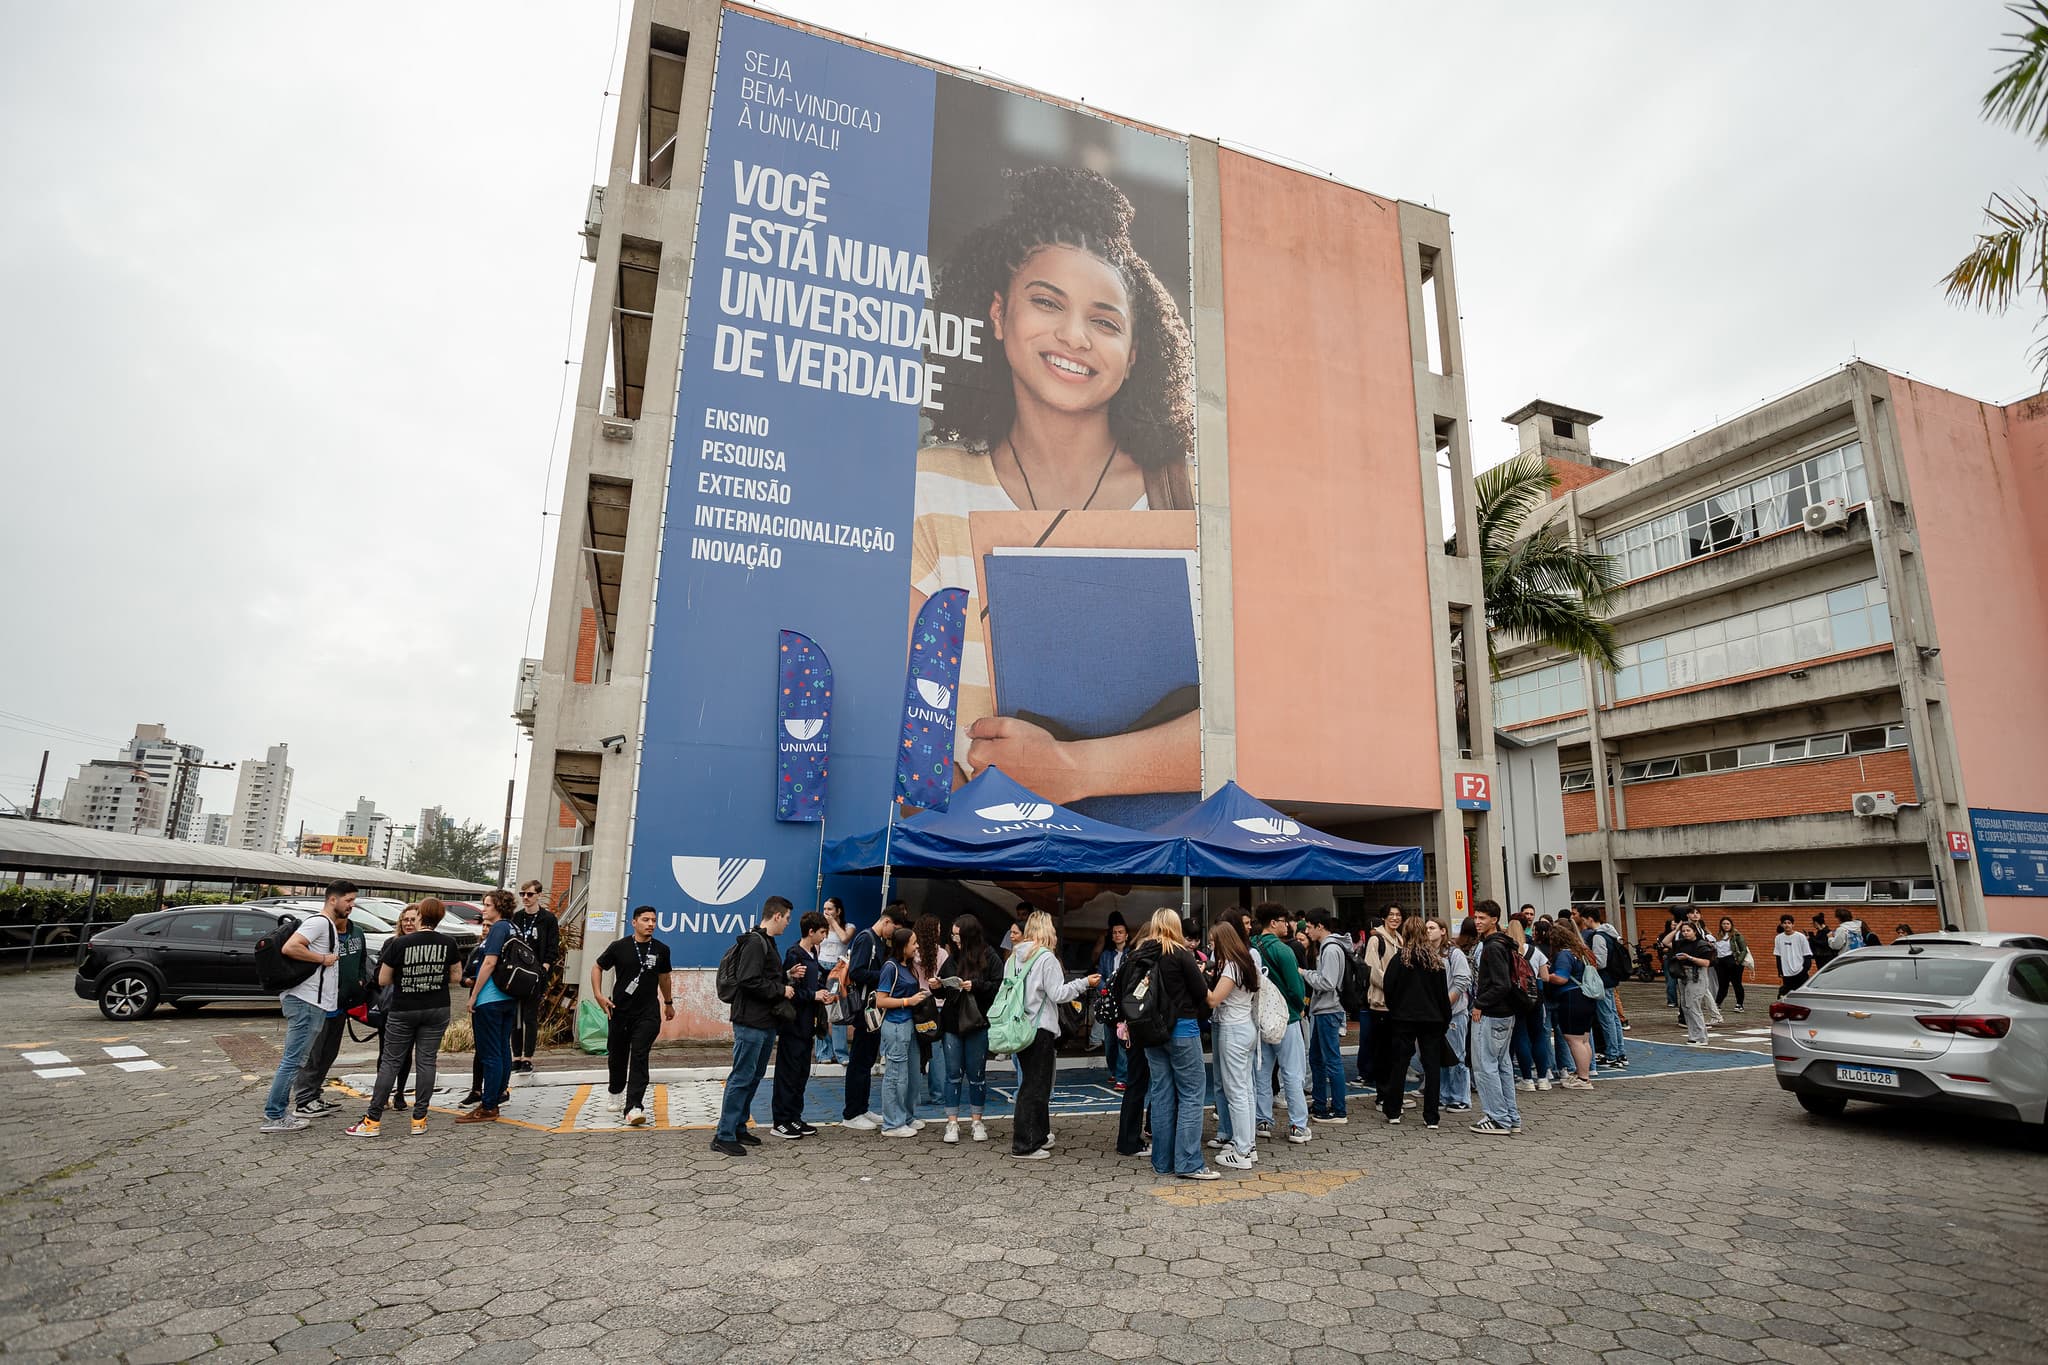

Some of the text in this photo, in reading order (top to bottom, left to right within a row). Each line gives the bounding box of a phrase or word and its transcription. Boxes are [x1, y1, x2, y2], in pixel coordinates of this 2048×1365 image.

[744, 50, 792, 82] SEJA
[741, 77, 881, 133] BEM-VINDO(A)
[738, 102, 841, 151] À UNIVALI!
[733, 159, 831, 223] VOCÊ
[724, 213, 933, 299] ESTÁ NUMA
[719, 267, 985, 363] UNIVERSIDADE
[712, 324, 947, 411] DE VERDADE
[704, 407, 770, 437] ENSINO
[701, 439, 786, 472] PESQUISA
[697, 472, 791, 505] EXTENSÃO
[694, 504, 896, 553] INTERNACIONALIZAÇÃO
[690, 537, 782, 570] INOVAÇÃO
[780, 742, 827, 752] UNIVALI
[1462, 775, 1486, 799] F2
[982, 821, 1082, 834] UNIVALI
[1951, 833, 1968, 850] F5
[657, 911, 756, 934] UNIVAL
[404, 944, 447, 965] UNIVALI
